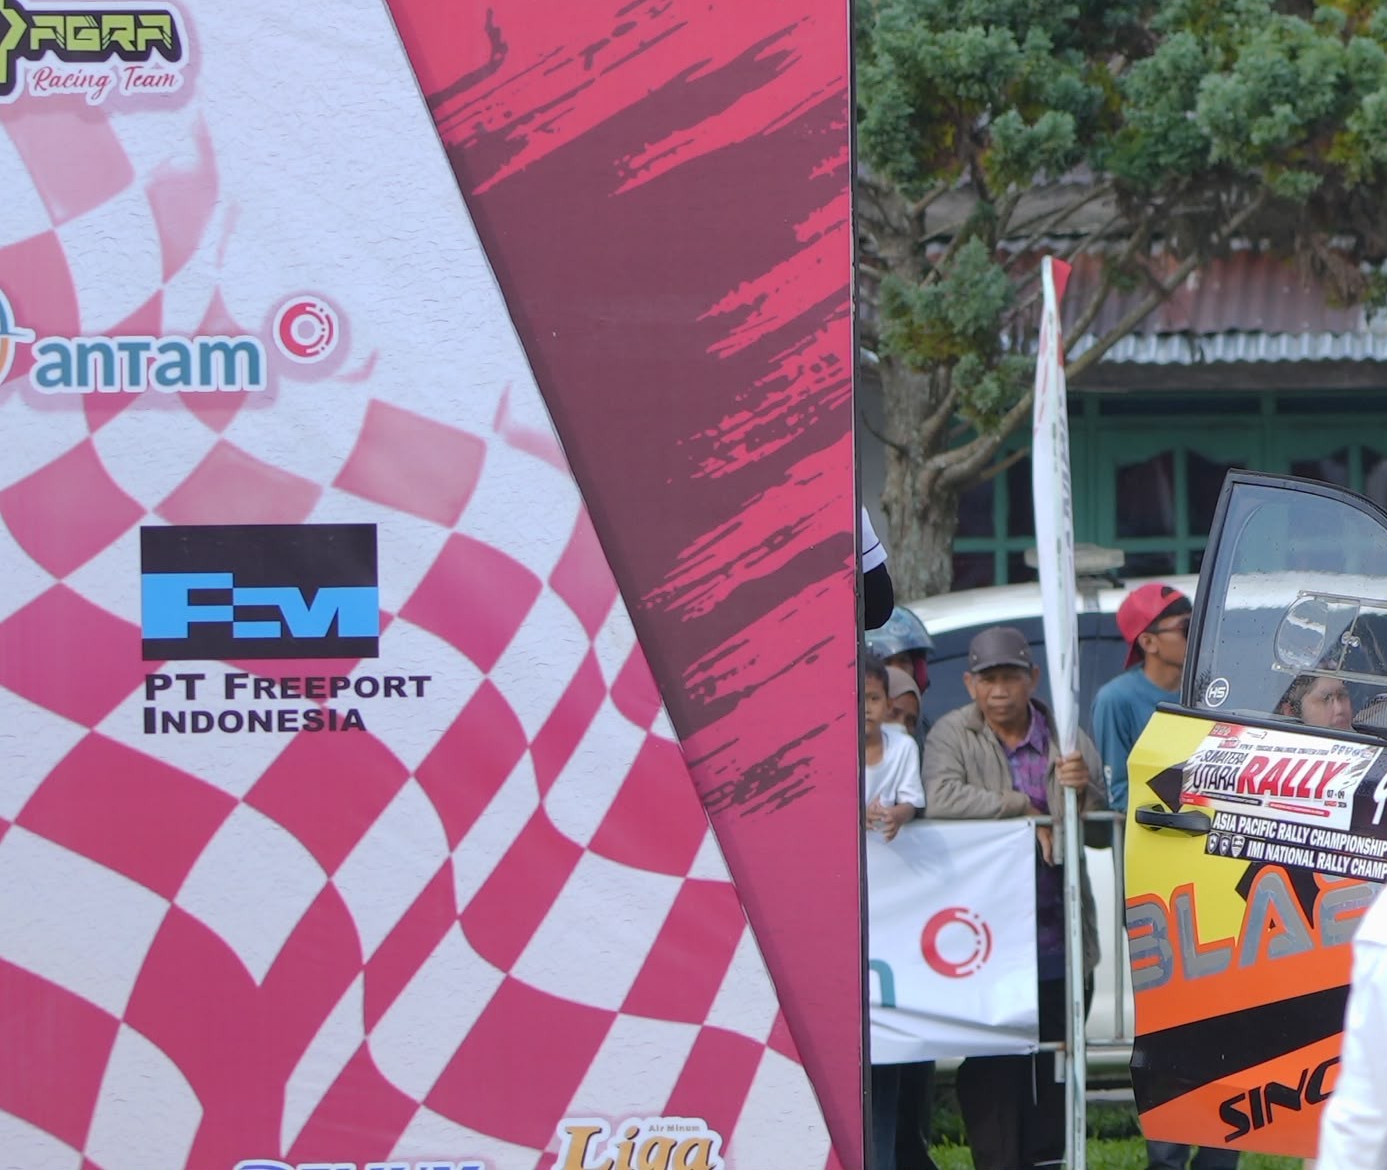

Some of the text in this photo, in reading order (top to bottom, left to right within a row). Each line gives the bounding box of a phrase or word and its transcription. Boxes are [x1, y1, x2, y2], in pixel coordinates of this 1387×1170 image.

[33, 65, 178, 99] Racing Team
[145, 672, 432, 701] PT FREEPORT
[143, 707, 366, 734] INDONESIA
[1192, 764, 1242, 792] UTARA
[1236, 755, 1350, 800] RALLY
[1213, 814, 1237, 833] ASIA
[1238, 818, 1278, 839] PACIFIC
[1277, 823, 1310, 844] RALLY
[1246, 840, 1265, 859] IMI
[1264, 843, 1314, 868] NATIONAL
[1316, 852, 1349, 874] RALLY
